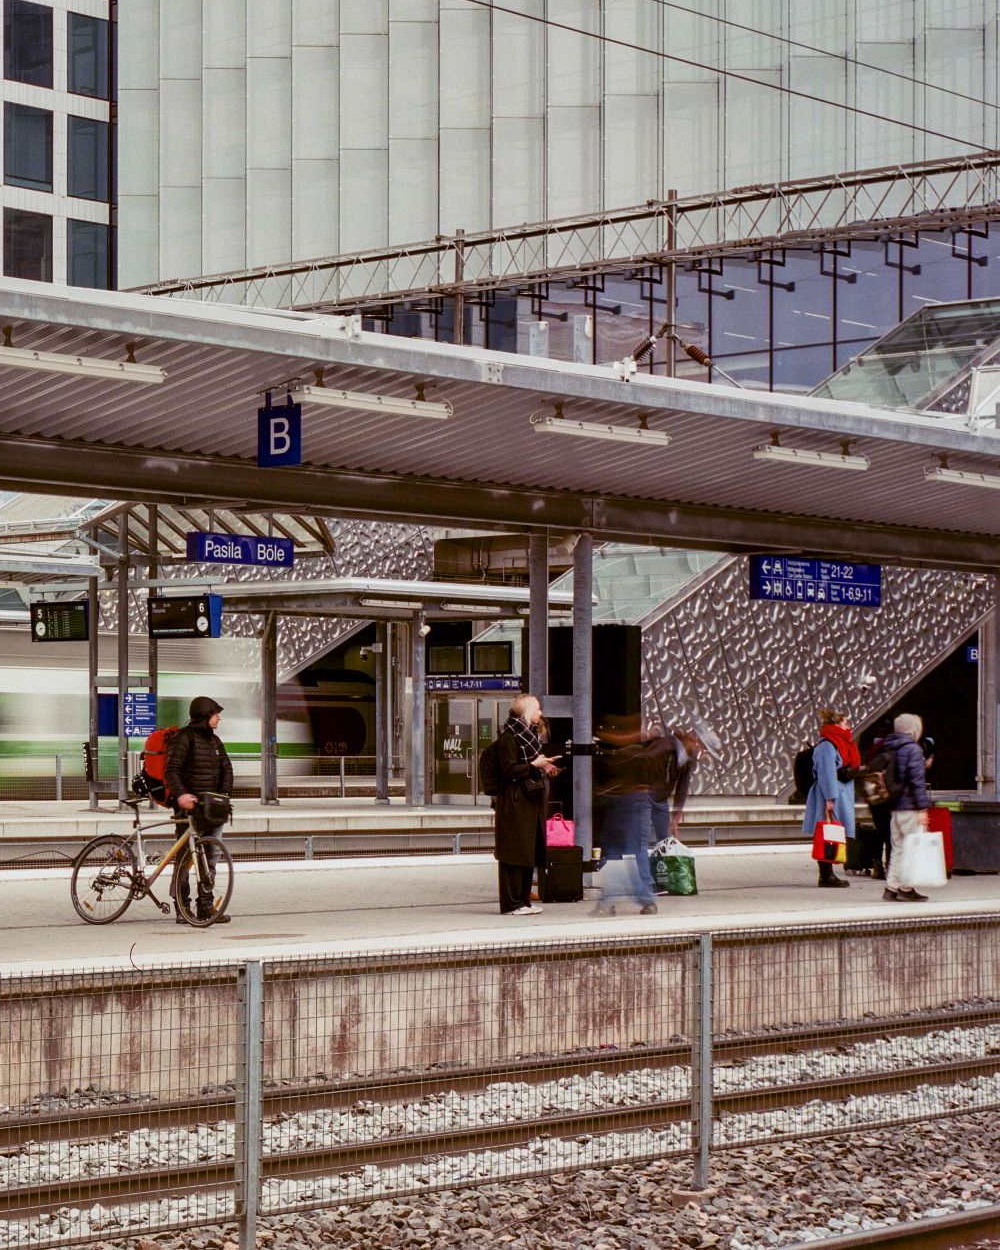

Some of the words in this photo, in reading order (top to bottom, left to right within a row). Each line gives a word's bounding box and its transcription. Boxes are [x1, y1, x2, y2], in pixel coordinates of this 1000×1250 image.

[270, 417, 291, 455] B
[205, 540, 242, 559] Pasila
[257, 543, 285, 562] Böle
[831, 565, 854, 579] 21-22
[841, 586, 872, 603] 1-6,9-11
[37, 608, 43, 619] 5
[199, 602, 205, 613] 6
[971, 648, 979, 660] B
